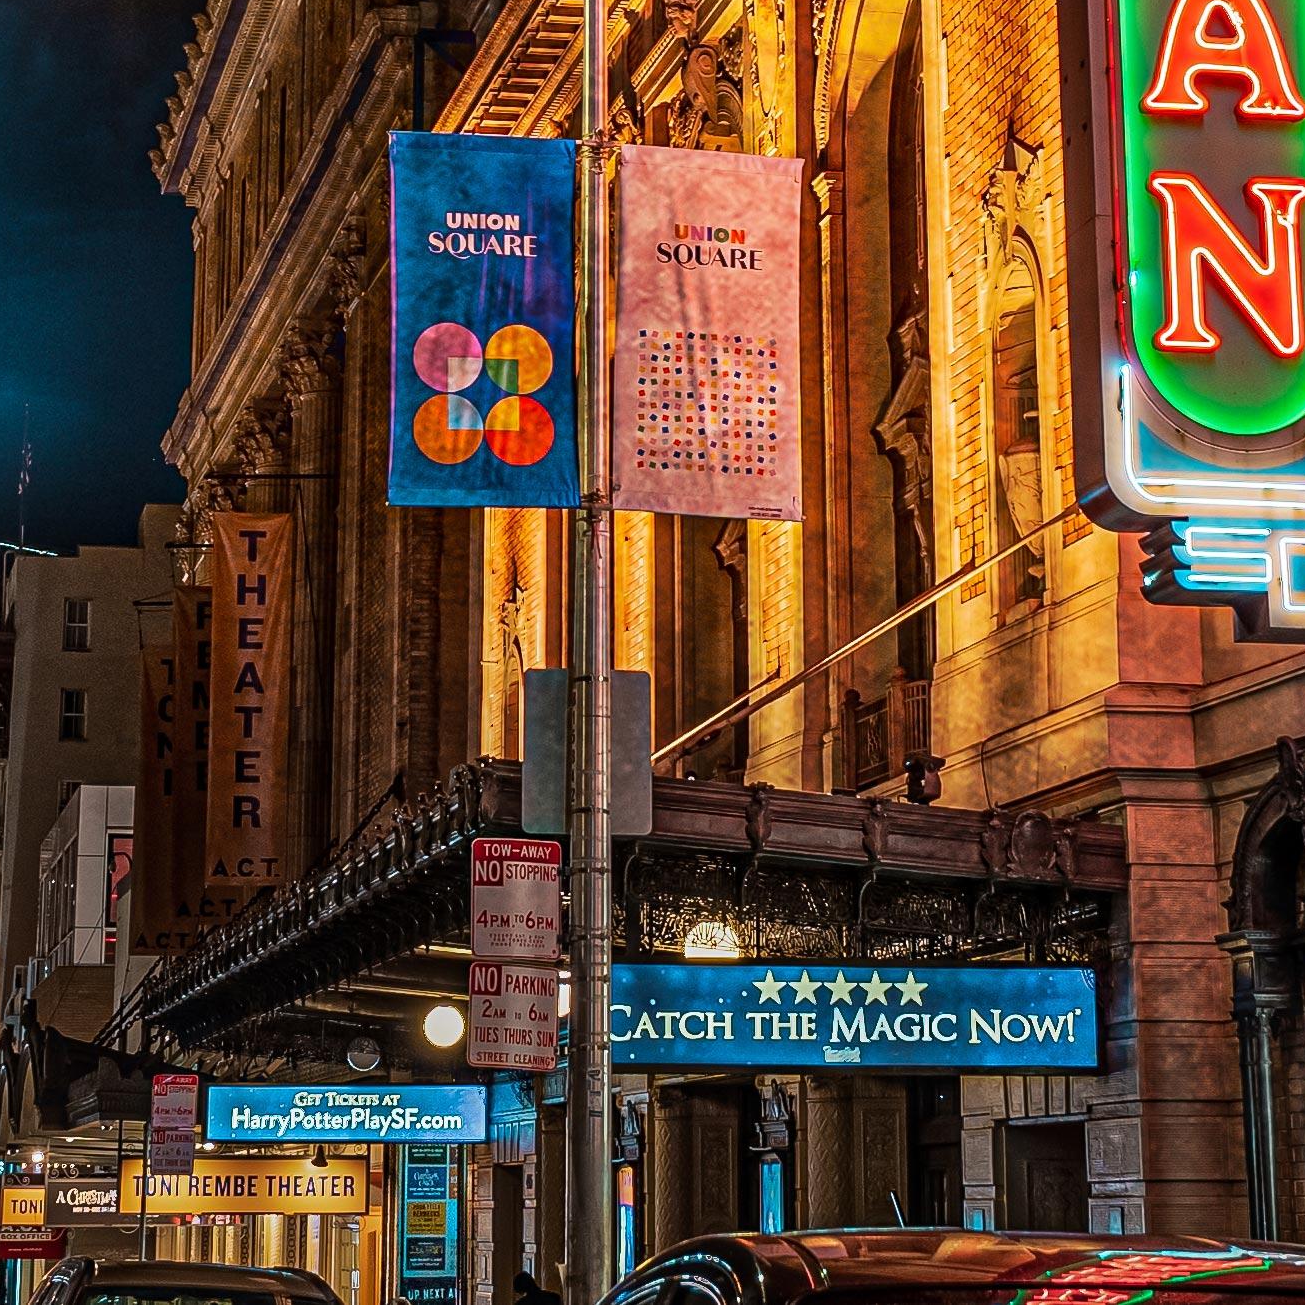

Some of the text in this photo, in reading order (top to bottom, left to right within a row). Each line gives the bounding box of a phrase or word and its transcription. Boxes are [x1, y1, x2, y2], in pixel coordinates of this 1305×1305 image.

[445, 212, 521, 232] UNION
[673, 223, 746, 245] UNION
[427, 231, 538, 260] SQUARE
[655, 242, 764, 271] SQUARE
[232, 530, 268, 829] THEATER
[483, 843, 552, 860] TOW-AWAY
[475, 860, 558, 883] NO STOPPING
[474, 966, 555, 997] NO PARKING
[481, 999, 506, 1018] 2AM
[528, 1003, 549, 1022] 6AM
[609, 1004, 733, 1041] CATCH
[746, 1011, 817, 1041] THE
[830, 1006, 957, 1043] MAGIC
[474, 1026, 554, 1048] TUES THURS SUN
[476, 1051, 553, 1066] STREET CLEANING
[294, 1091, 401, 1107] GET TICKETS AT
[232, 1106, 463, 1137] HarryPotterPlaySF.com
[133, 1175, 356, 1197] TONI REMBE THEATER
[11, 1199, 43, 1215] TONI
[407, 1289, 420, 1300] UP
[423, 1287, 446, 1300] NEXT
